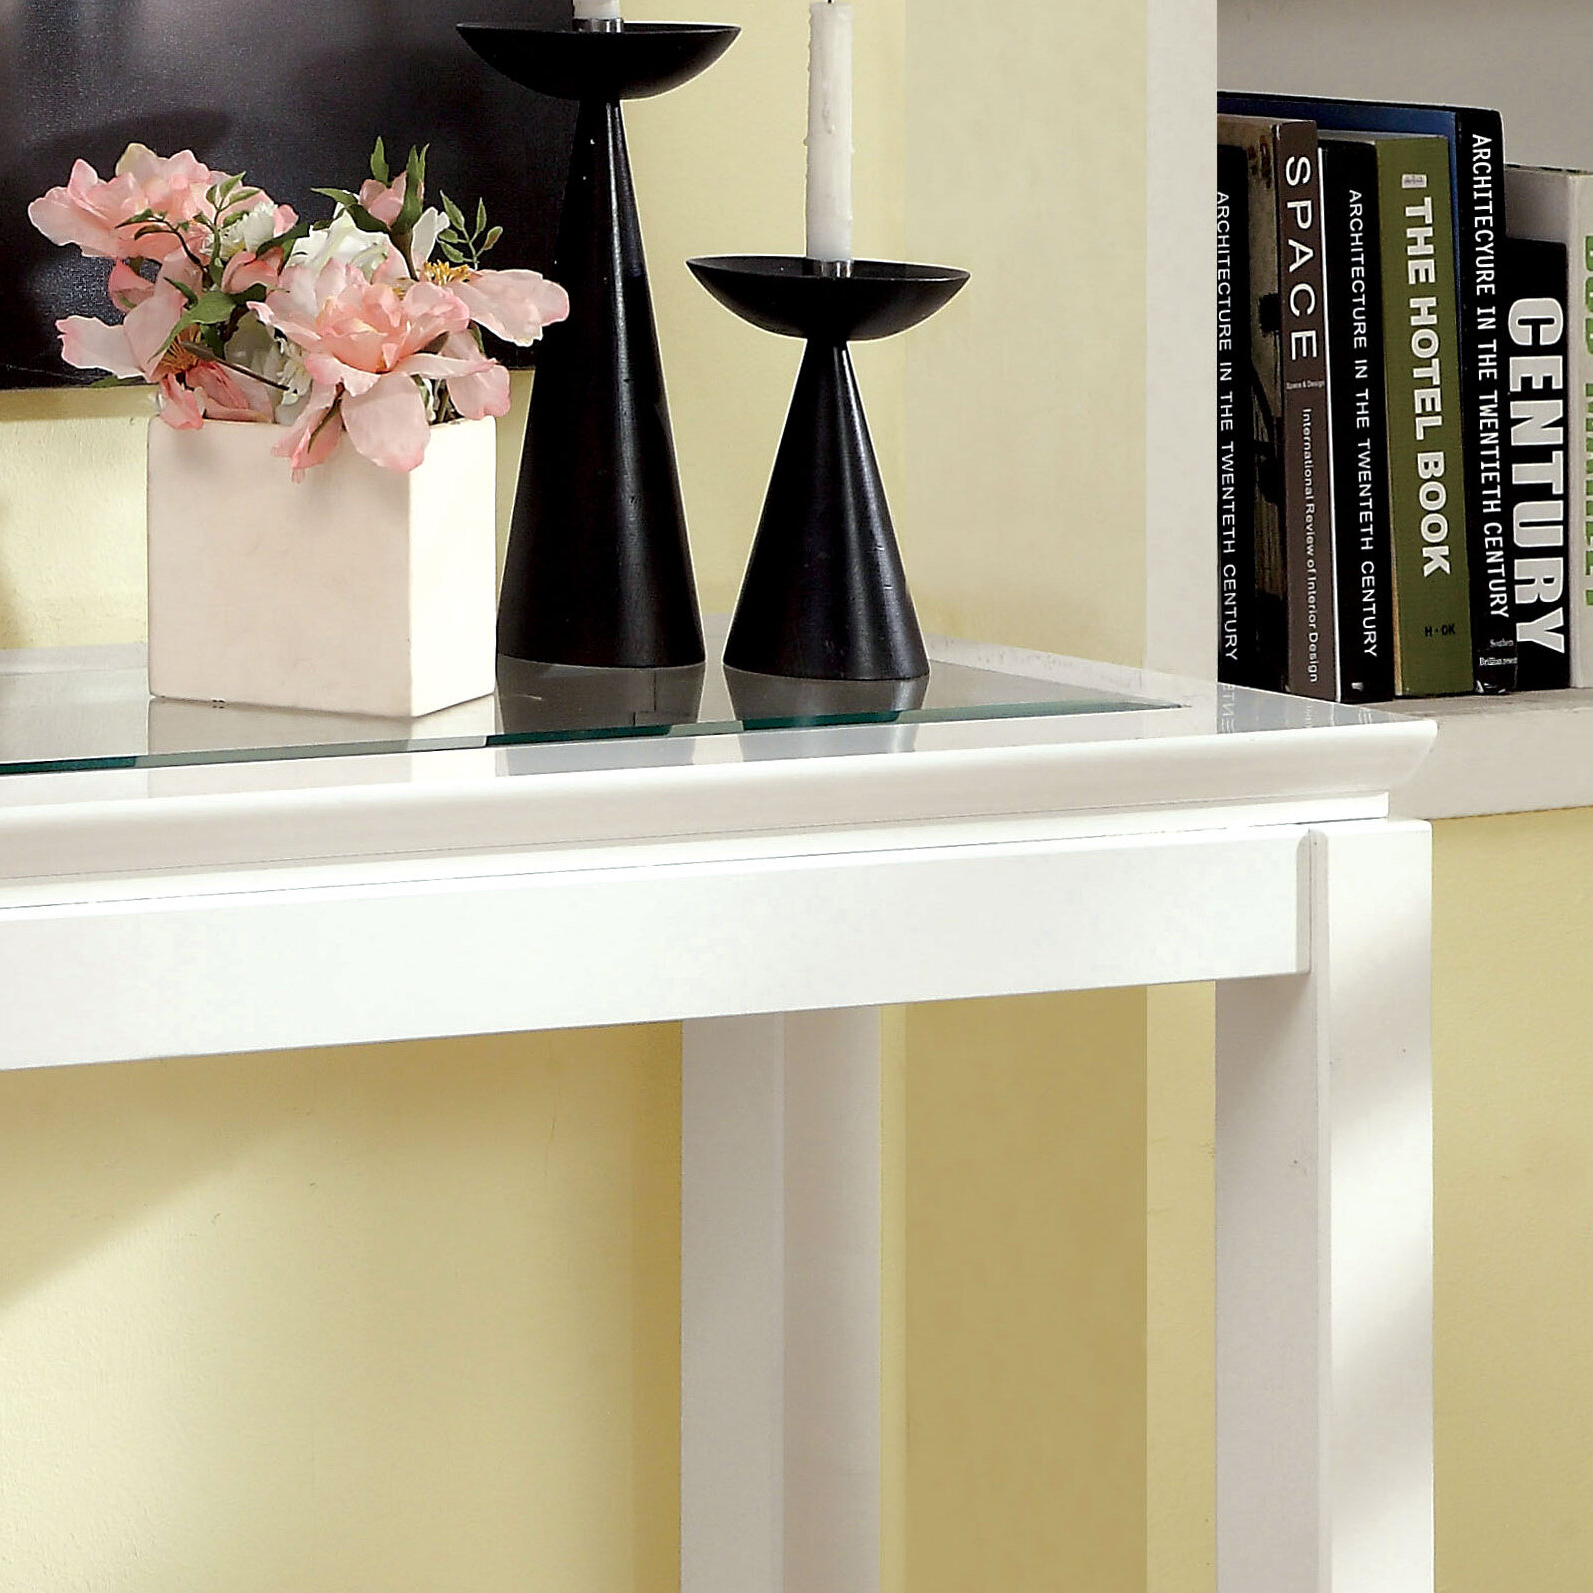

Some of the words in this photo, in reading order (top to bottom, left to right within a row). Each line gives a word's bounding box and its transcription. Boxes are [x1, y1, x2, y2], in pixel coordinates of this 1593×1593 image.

[1286, 156, 1317, 360] SPACE
[1405, 196, 1436, 285] THE
[1472, 133, 1496, 296] ARCHITECYURE
[1217, 191, 1232, 351] ARCHITECTURE
[1349, 189, 1367, 349] ARCHITECTURE
[1476, 306, 1497, 330] IN
[1477, 338, 1498, 381] THE
[1219, 362, 1232, 381] IN
[1220, 391, 1234, 432] THE
[1354, 359, 1368, 379] IN
[1355, 388, 1370, 429] THE
[1409, 296, 1443, 441] HOTEL
[1221, 440, 1236, 553] TWENTETH
[1357, 437, 1374, 550] TWENTETH
[1478, 389, 1502, 513] TWENTIETH
[1507, 297, 1565, 654] CENTURY
[1417, 451, 1451, 578] BOOK
[1223, 564, 1238, 660] CENTURY
[1360, 560, 1378, 657] CENTURY
[1483, 522, 1510, 618] CENTURY
[1307, 631, 1320, 683] Design
